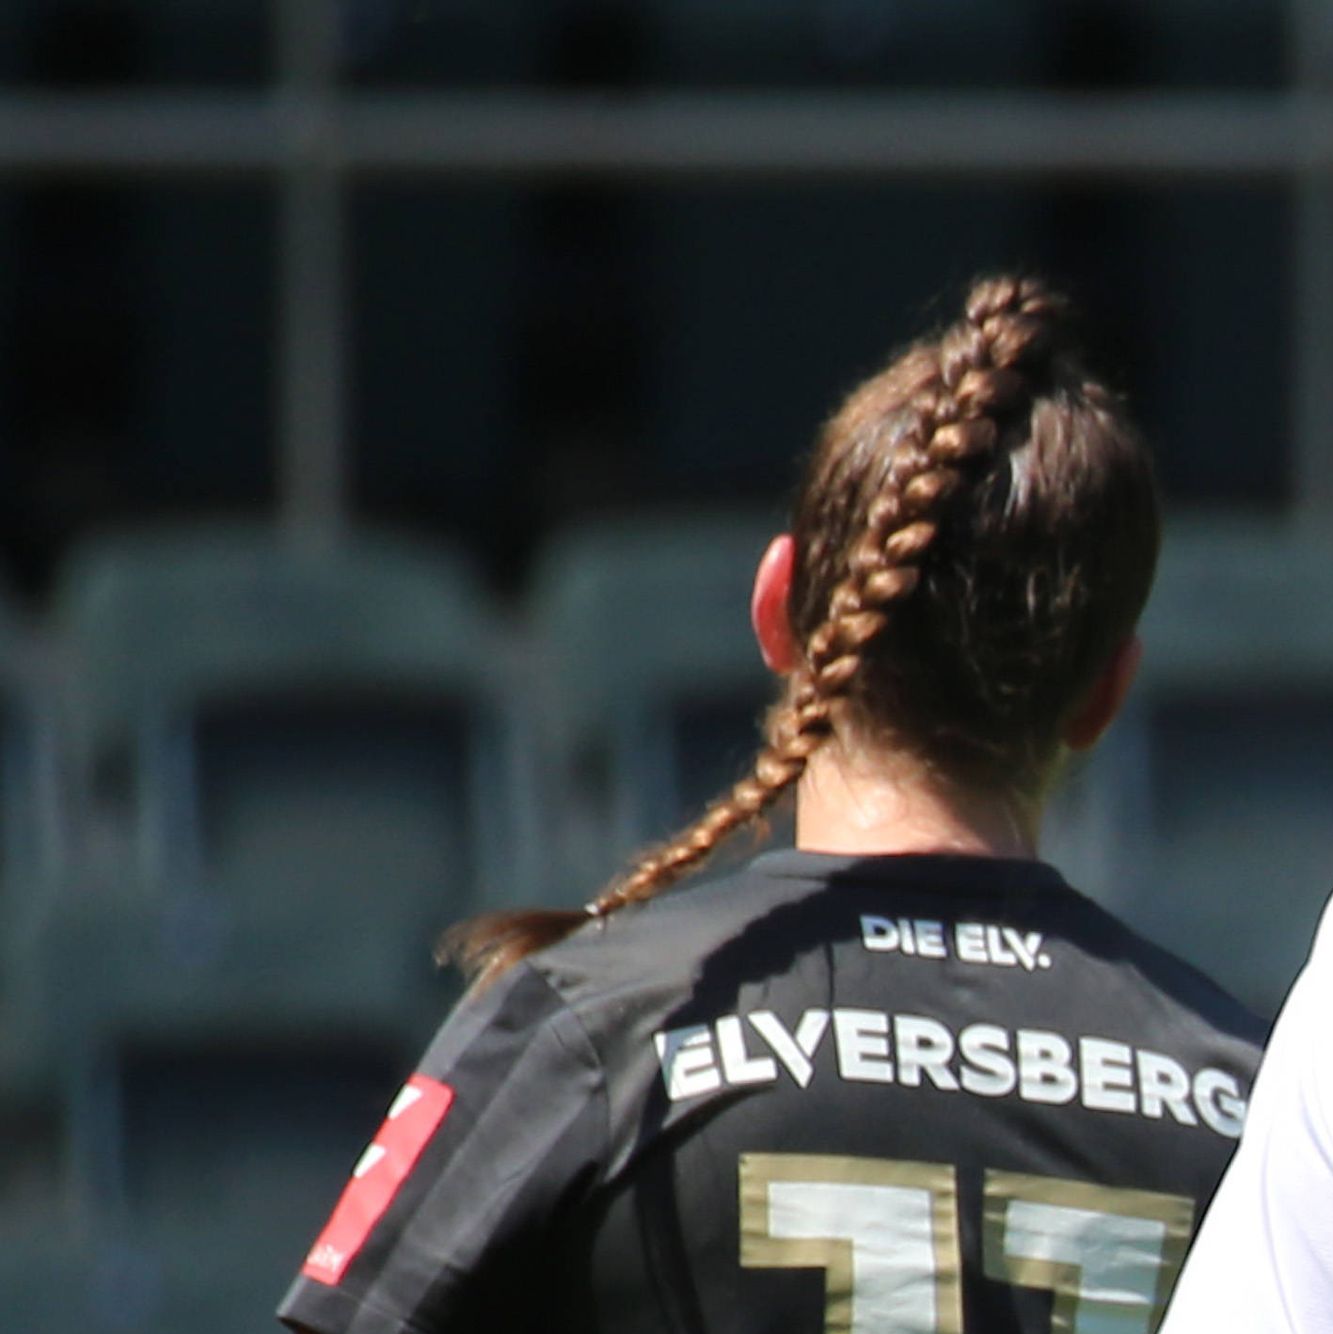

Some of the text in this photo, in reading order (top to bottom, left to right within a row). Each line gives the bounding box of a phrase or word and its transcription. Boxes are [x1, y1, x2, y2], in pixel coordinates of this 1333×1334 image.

[859, 914, 1051, 972] DIE ELV.
[653, 1006, 1248, 1140] ELVERSBERG
